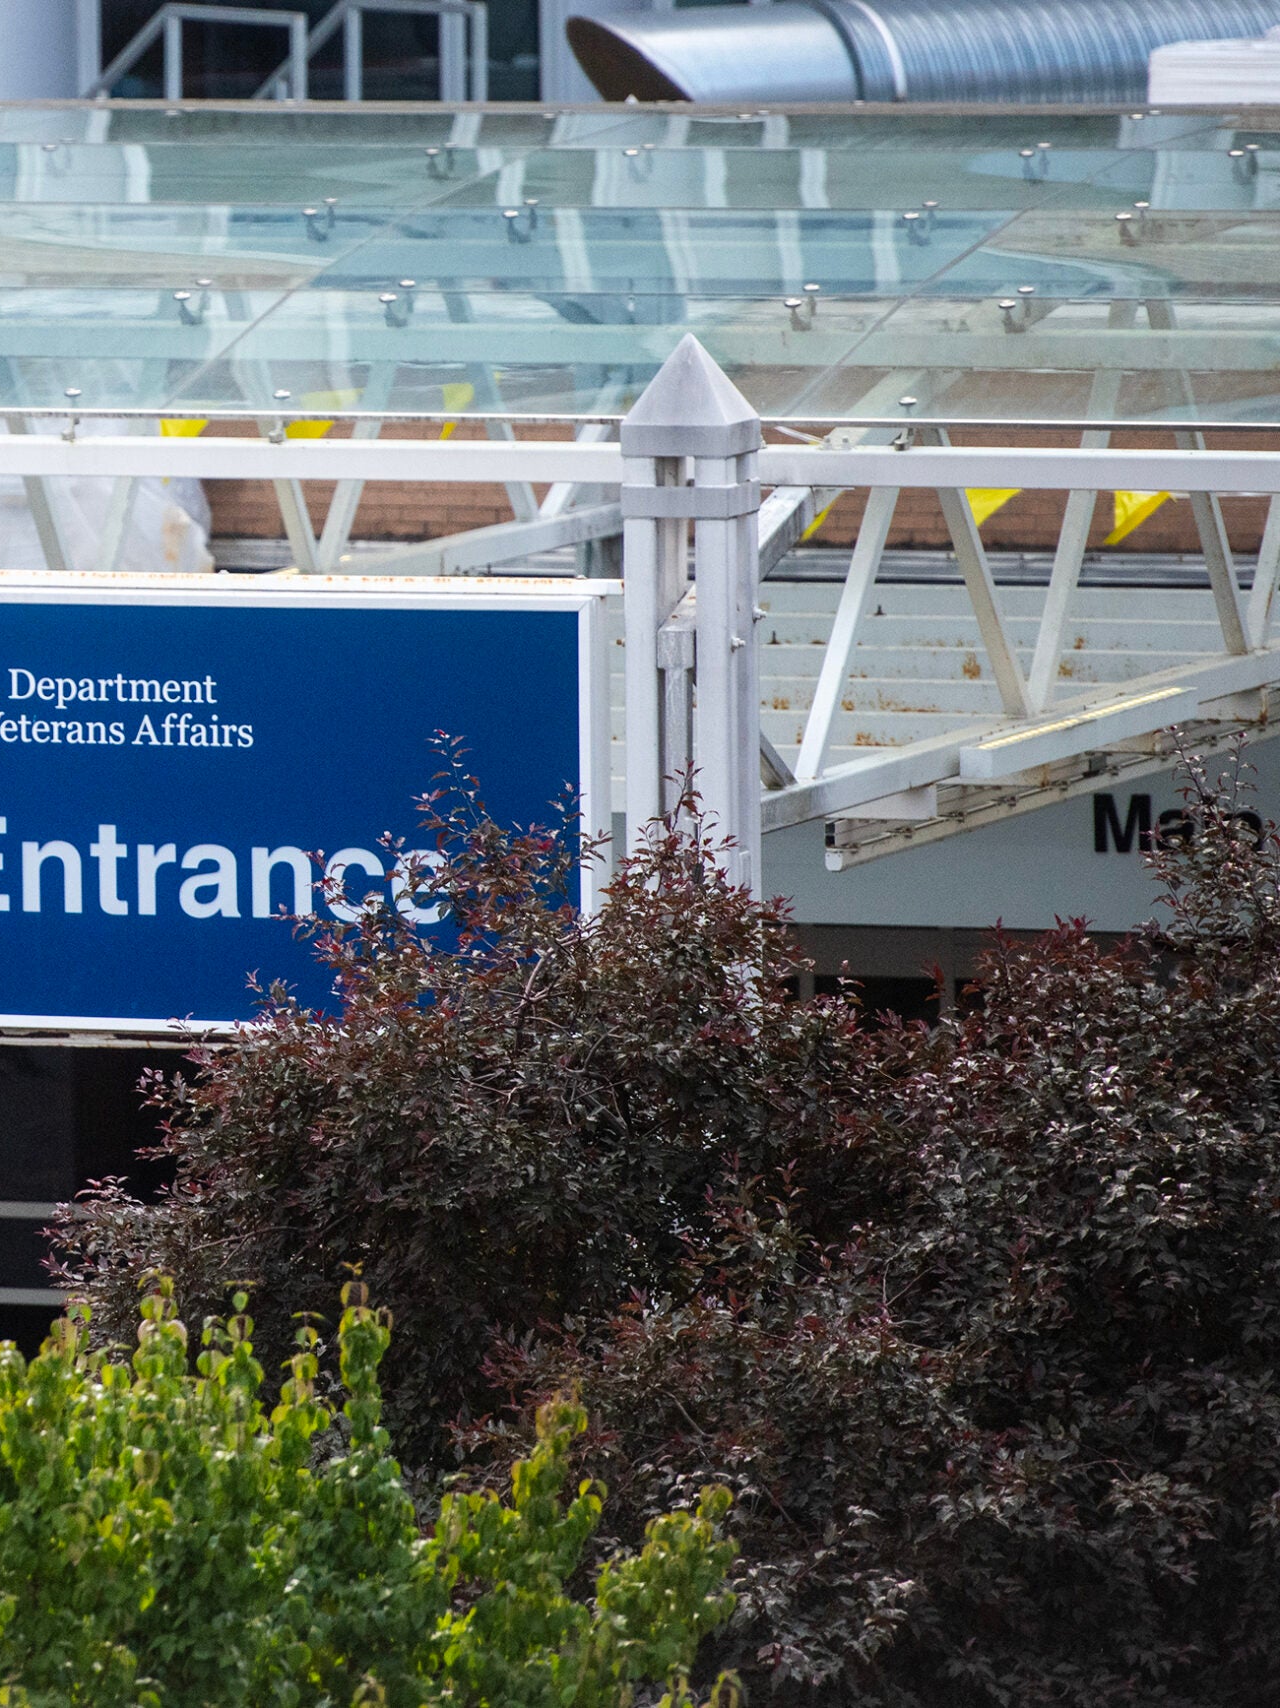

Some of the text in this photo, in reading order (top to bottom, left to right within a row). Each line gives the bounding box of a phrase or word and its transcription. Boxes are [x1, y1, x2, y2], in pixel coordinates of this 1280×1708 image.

[8, 668, 218, 710] Department
[131, 712, 255, 748] Affairs
[1093, 793, 1263, 853] Man
